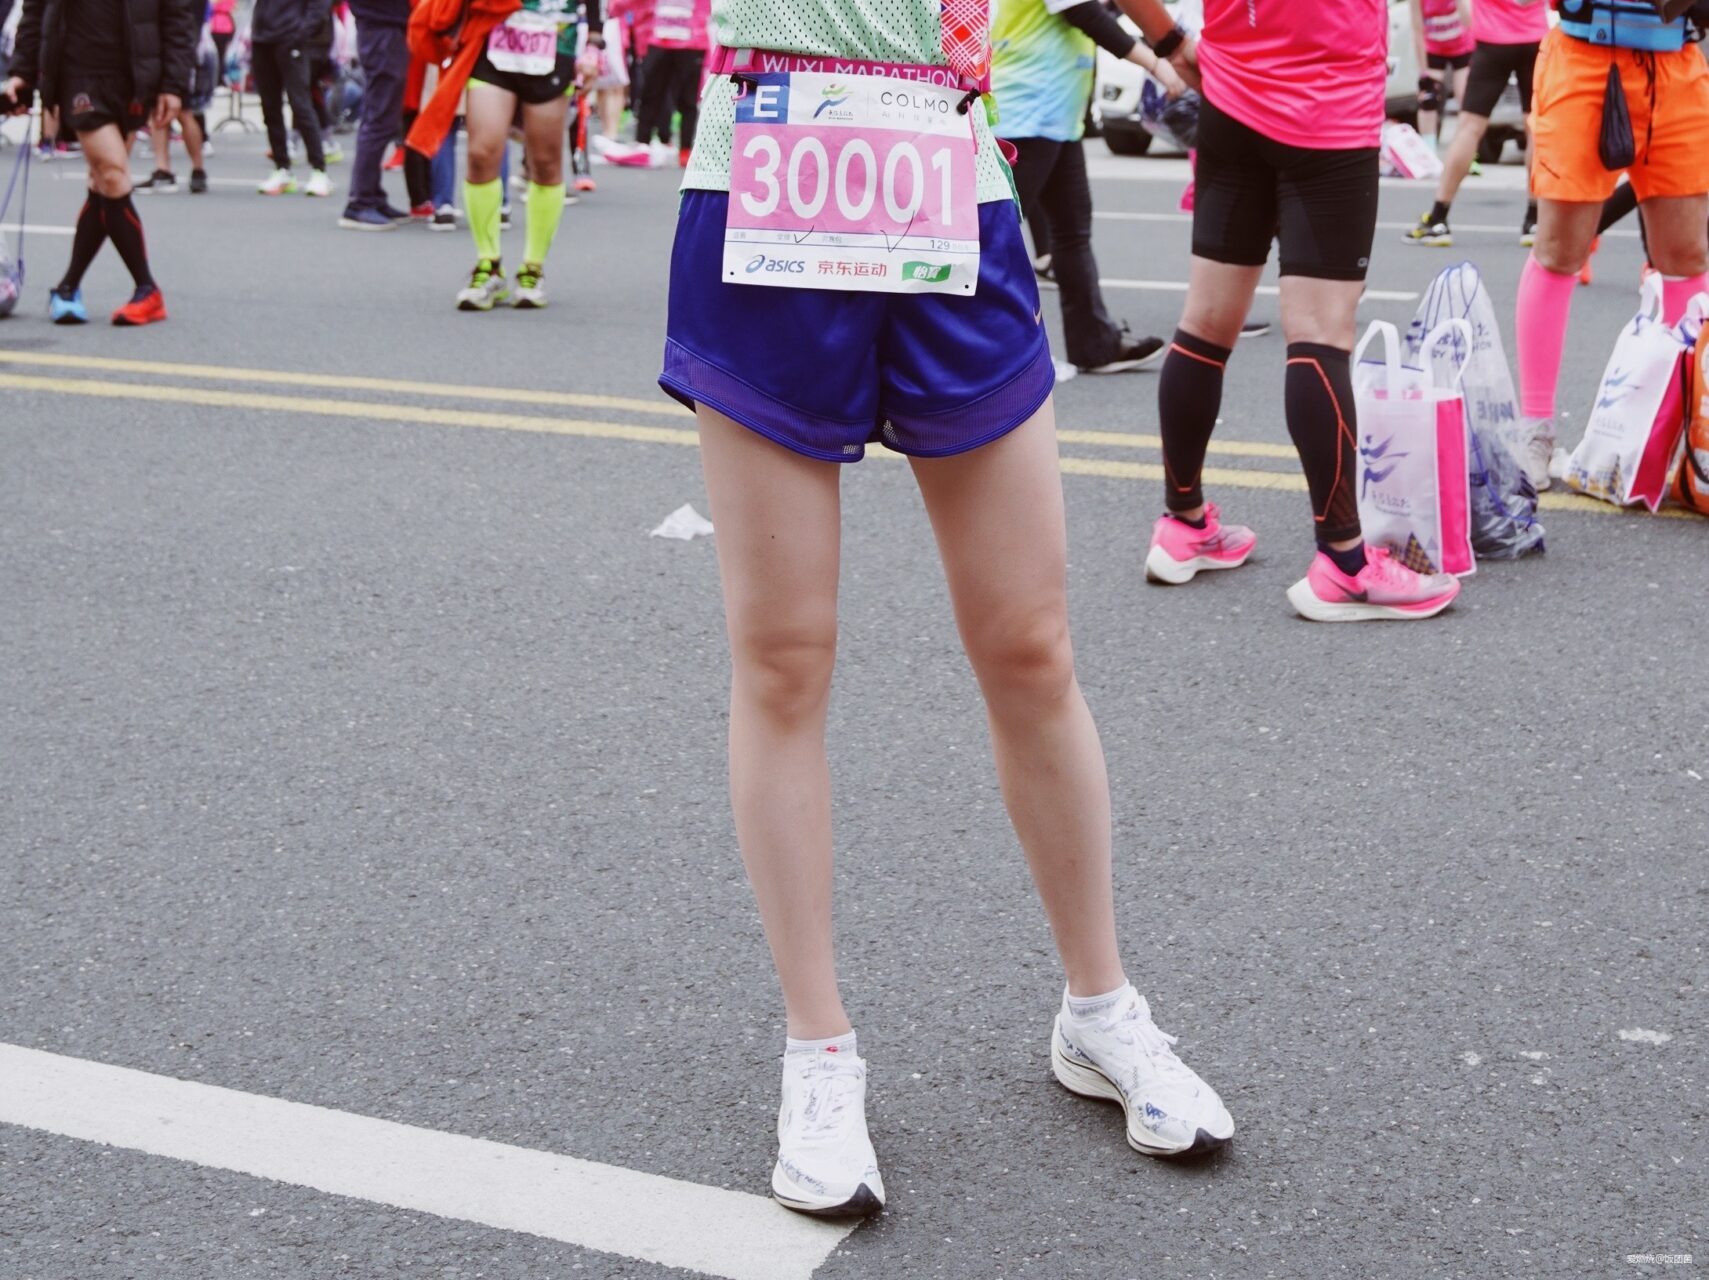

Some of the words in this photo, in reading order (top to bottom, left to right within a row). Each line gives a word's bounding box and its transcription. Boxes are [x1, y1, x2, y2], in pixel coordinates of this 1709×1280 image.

[753, 85, 782, 118] E
[880, 91, 949, 114] COLMO
[739, 134, 954, 227] 30001
[930, 239, 950, 251] 129
[817, 260, 888, 277] 京东运动
